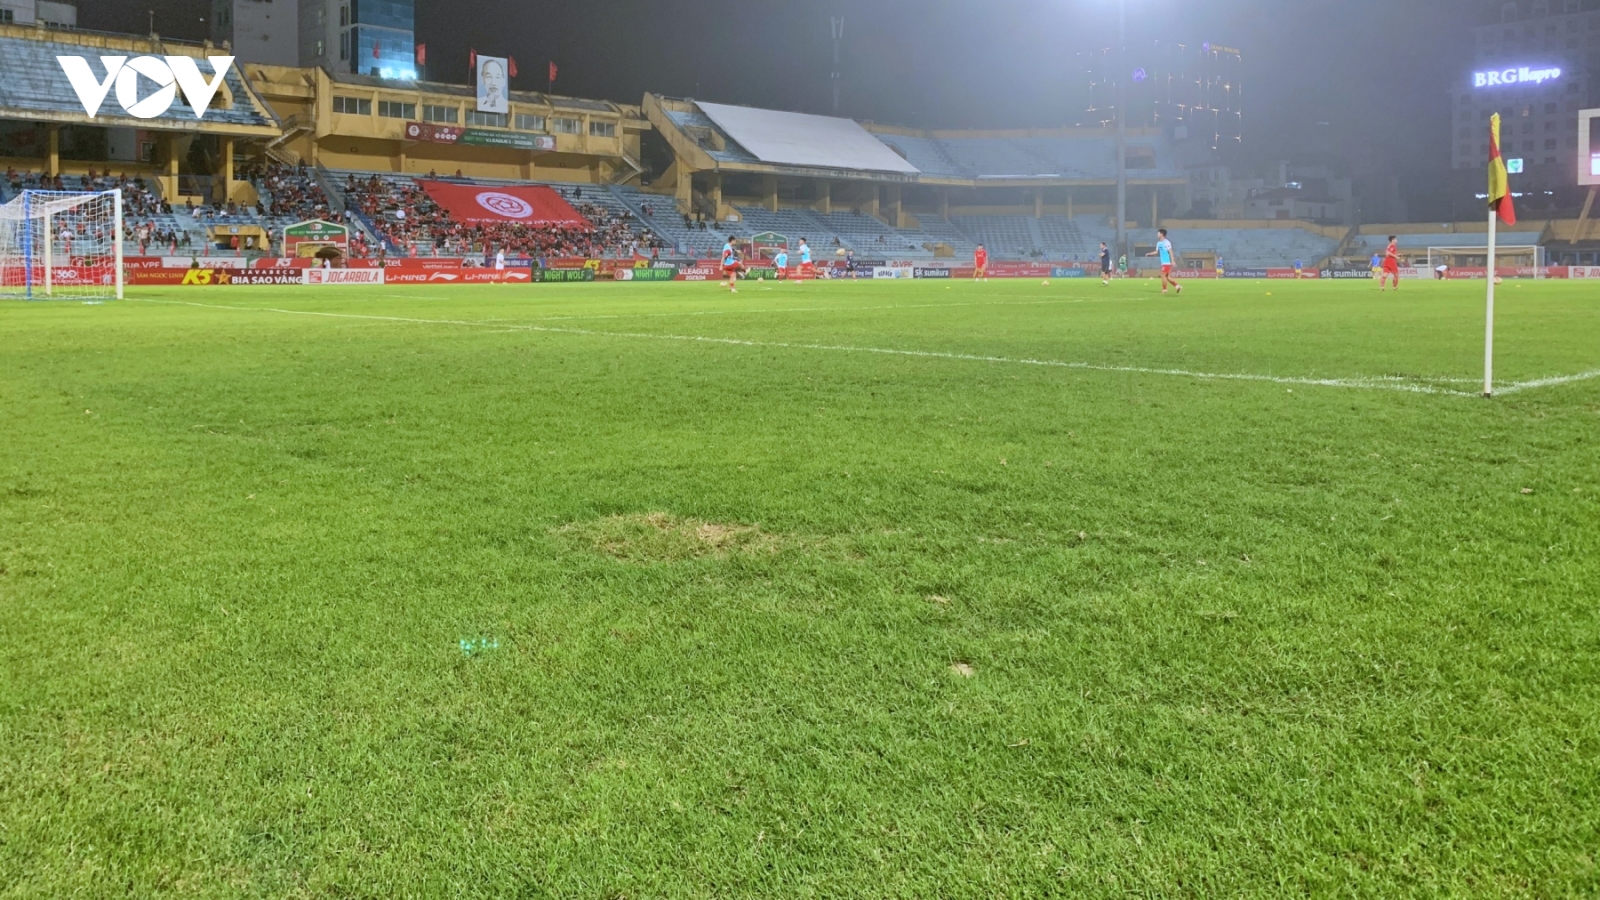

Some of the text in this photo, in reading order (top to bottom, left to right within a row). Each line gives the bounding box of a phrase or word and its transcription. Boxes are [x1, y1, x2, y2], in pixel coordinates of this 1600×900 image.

[181, 269, 214, 284] K5
[325, 272, 378, 282] JOGARBOLA
[544, 271, 585, 279] NIGHT WOLF
[635, 269, 671, 278] NIGHT WOLF
[1321, 269, 1372, 277] sk sumikura
[274, 275, 302, 284] VÀNG
